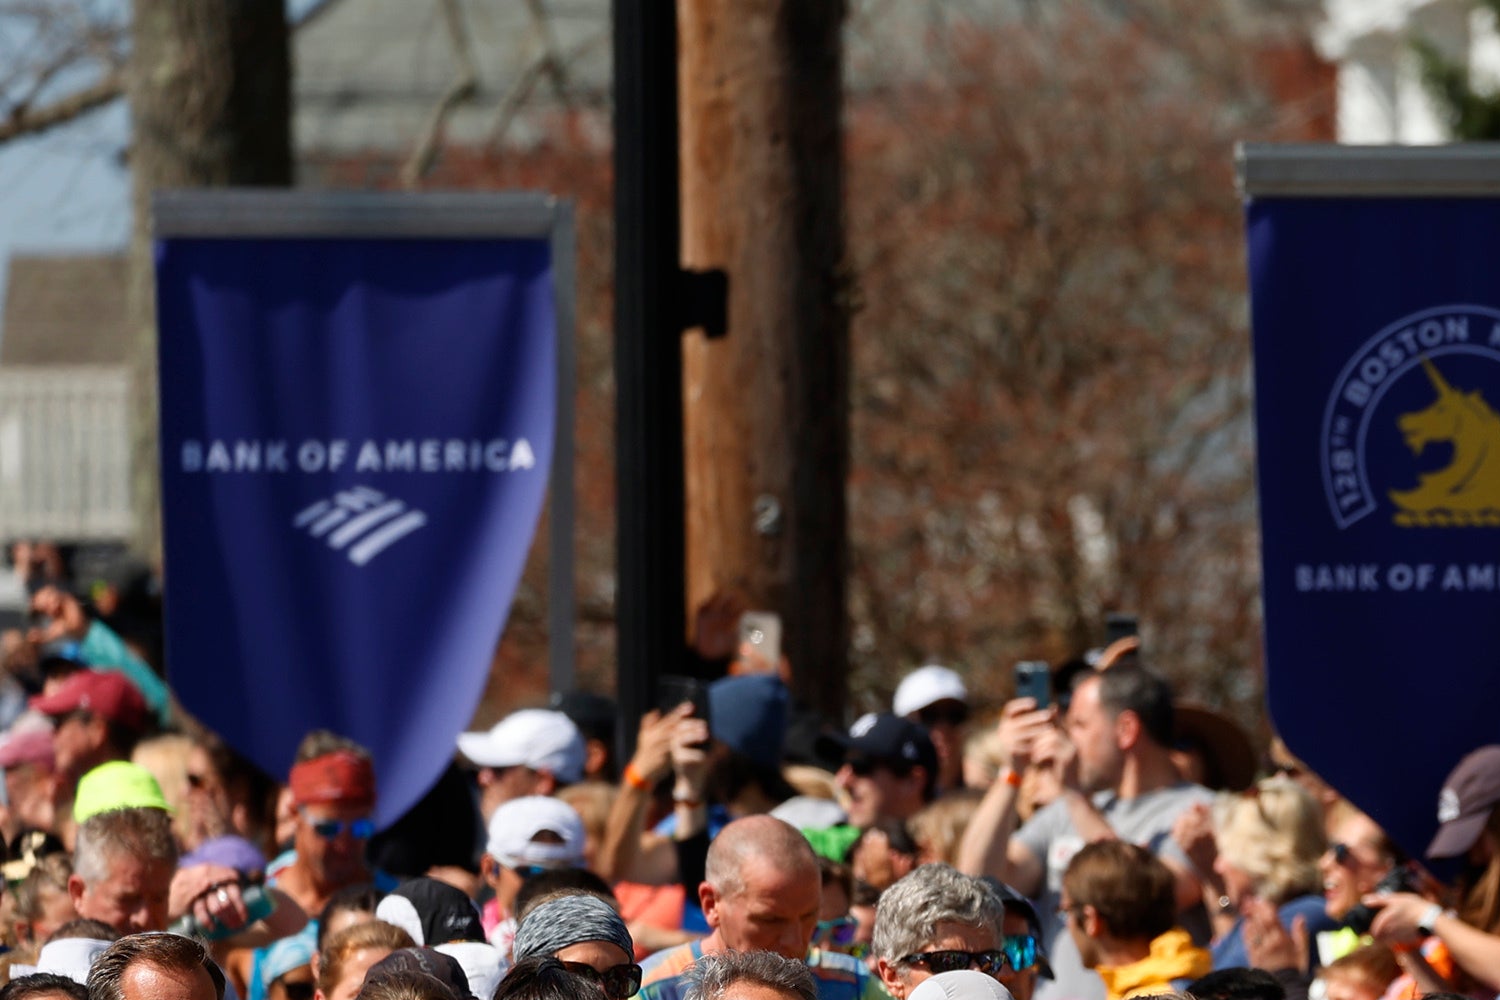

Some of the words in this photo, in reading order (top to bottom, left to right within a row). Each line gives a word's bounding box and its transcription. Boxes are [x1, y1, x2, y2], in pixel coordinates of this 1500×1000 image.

[1344, 316, 1468, 407] BOSTON
[181, 440, 289, 472] BANK
[297, 440, 346, 472] OF
[356, 438, 536, 472] AMERICA
[1296, 563, 1379, 592] BANK
[1388, 563, 1436, 592] OF
